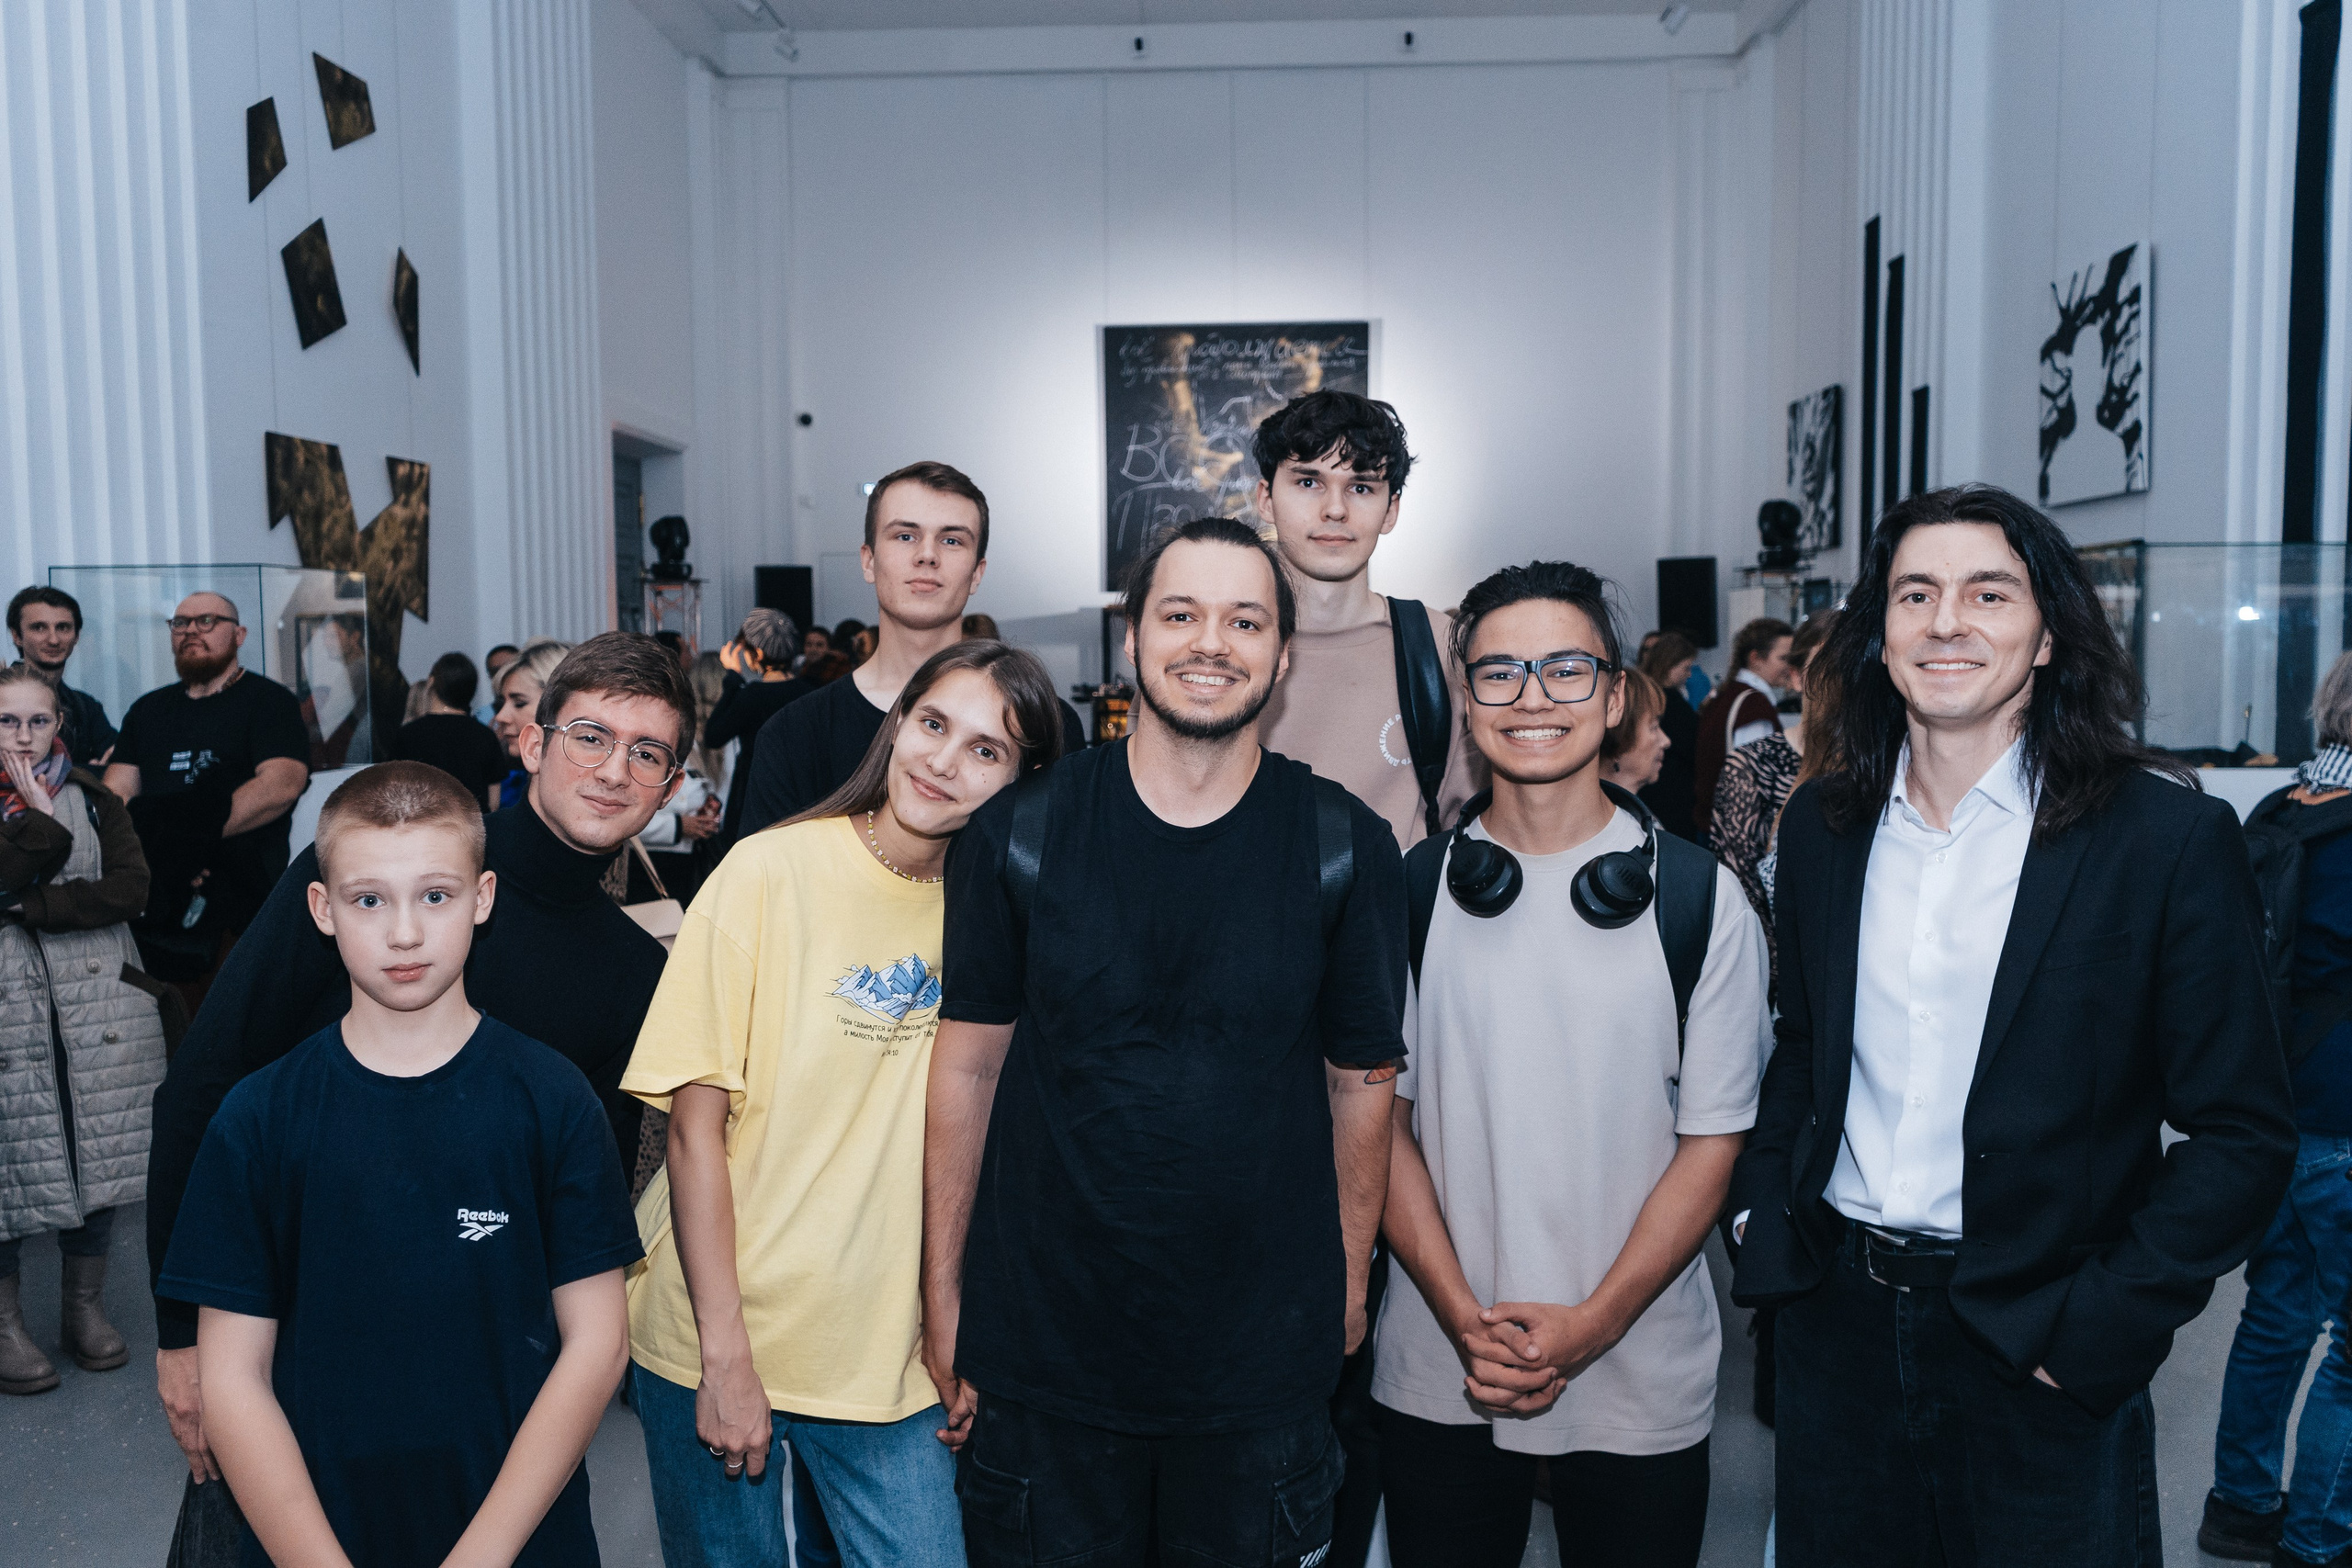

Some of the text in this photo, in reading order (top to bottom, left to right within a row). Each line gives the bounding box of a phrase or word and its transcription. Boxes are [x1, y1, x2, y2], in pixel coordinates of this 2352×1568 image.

[836, 1014, 853, 1026] Горы
[854, 1021, 886, 1032] сдвинутся
[850, 1031, 875, 1042] милость
[457, 1208, 510, 1224] Reebok
